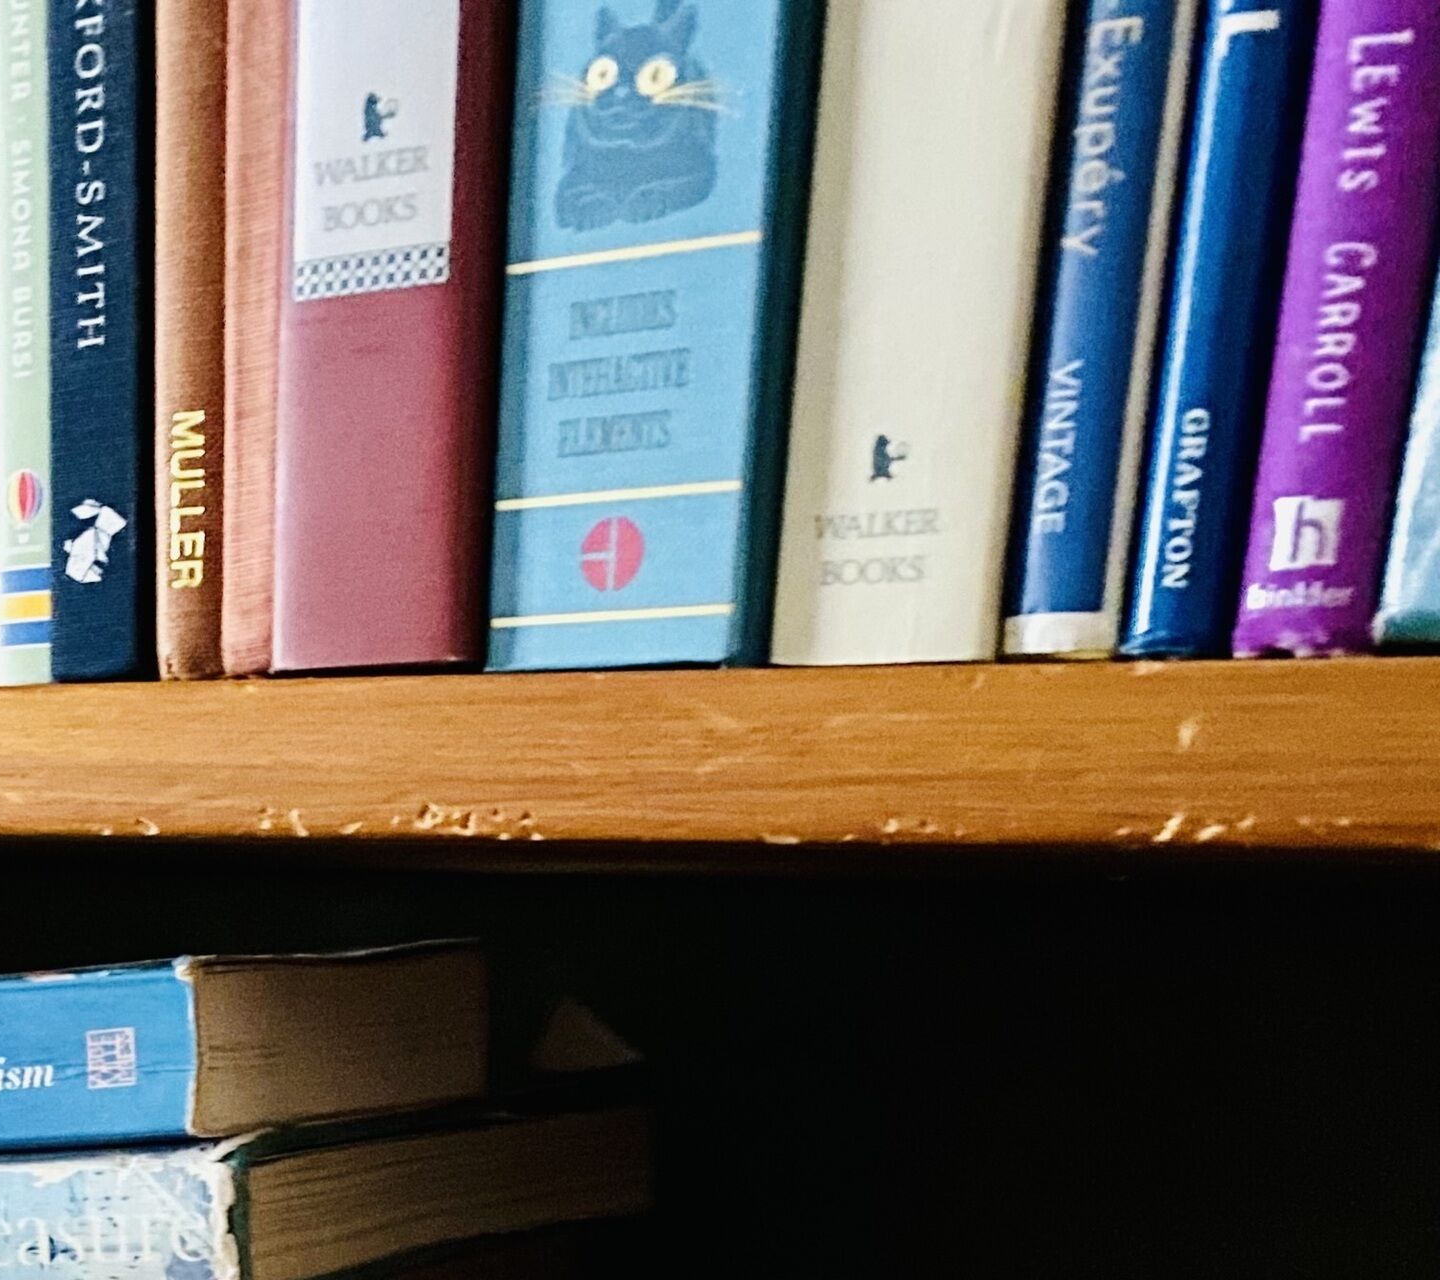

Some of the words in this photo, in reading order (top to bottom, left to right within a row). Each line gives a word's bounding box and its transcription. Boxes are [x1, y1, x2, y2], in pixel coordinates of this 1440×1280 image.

[312, 146, 430, 188] WALKER
[1338, 30, 1414, 192] LEWIS
[11, 138, 32, 271] SIMONA
[321, 197, 419, 233] BOOKS
[12, 286, 33, 379] BURSI
[1298, 242, 1379, 443] CARROLL
[170, 409, 206, 590] MULLER
[1034, 360, 1084, 534] VINTAGE
[1160, 407, 1211, 590] GRAFTON
[813, 508, 940, 541] WALKER
[820, 555, 926, 588] BOOKS
